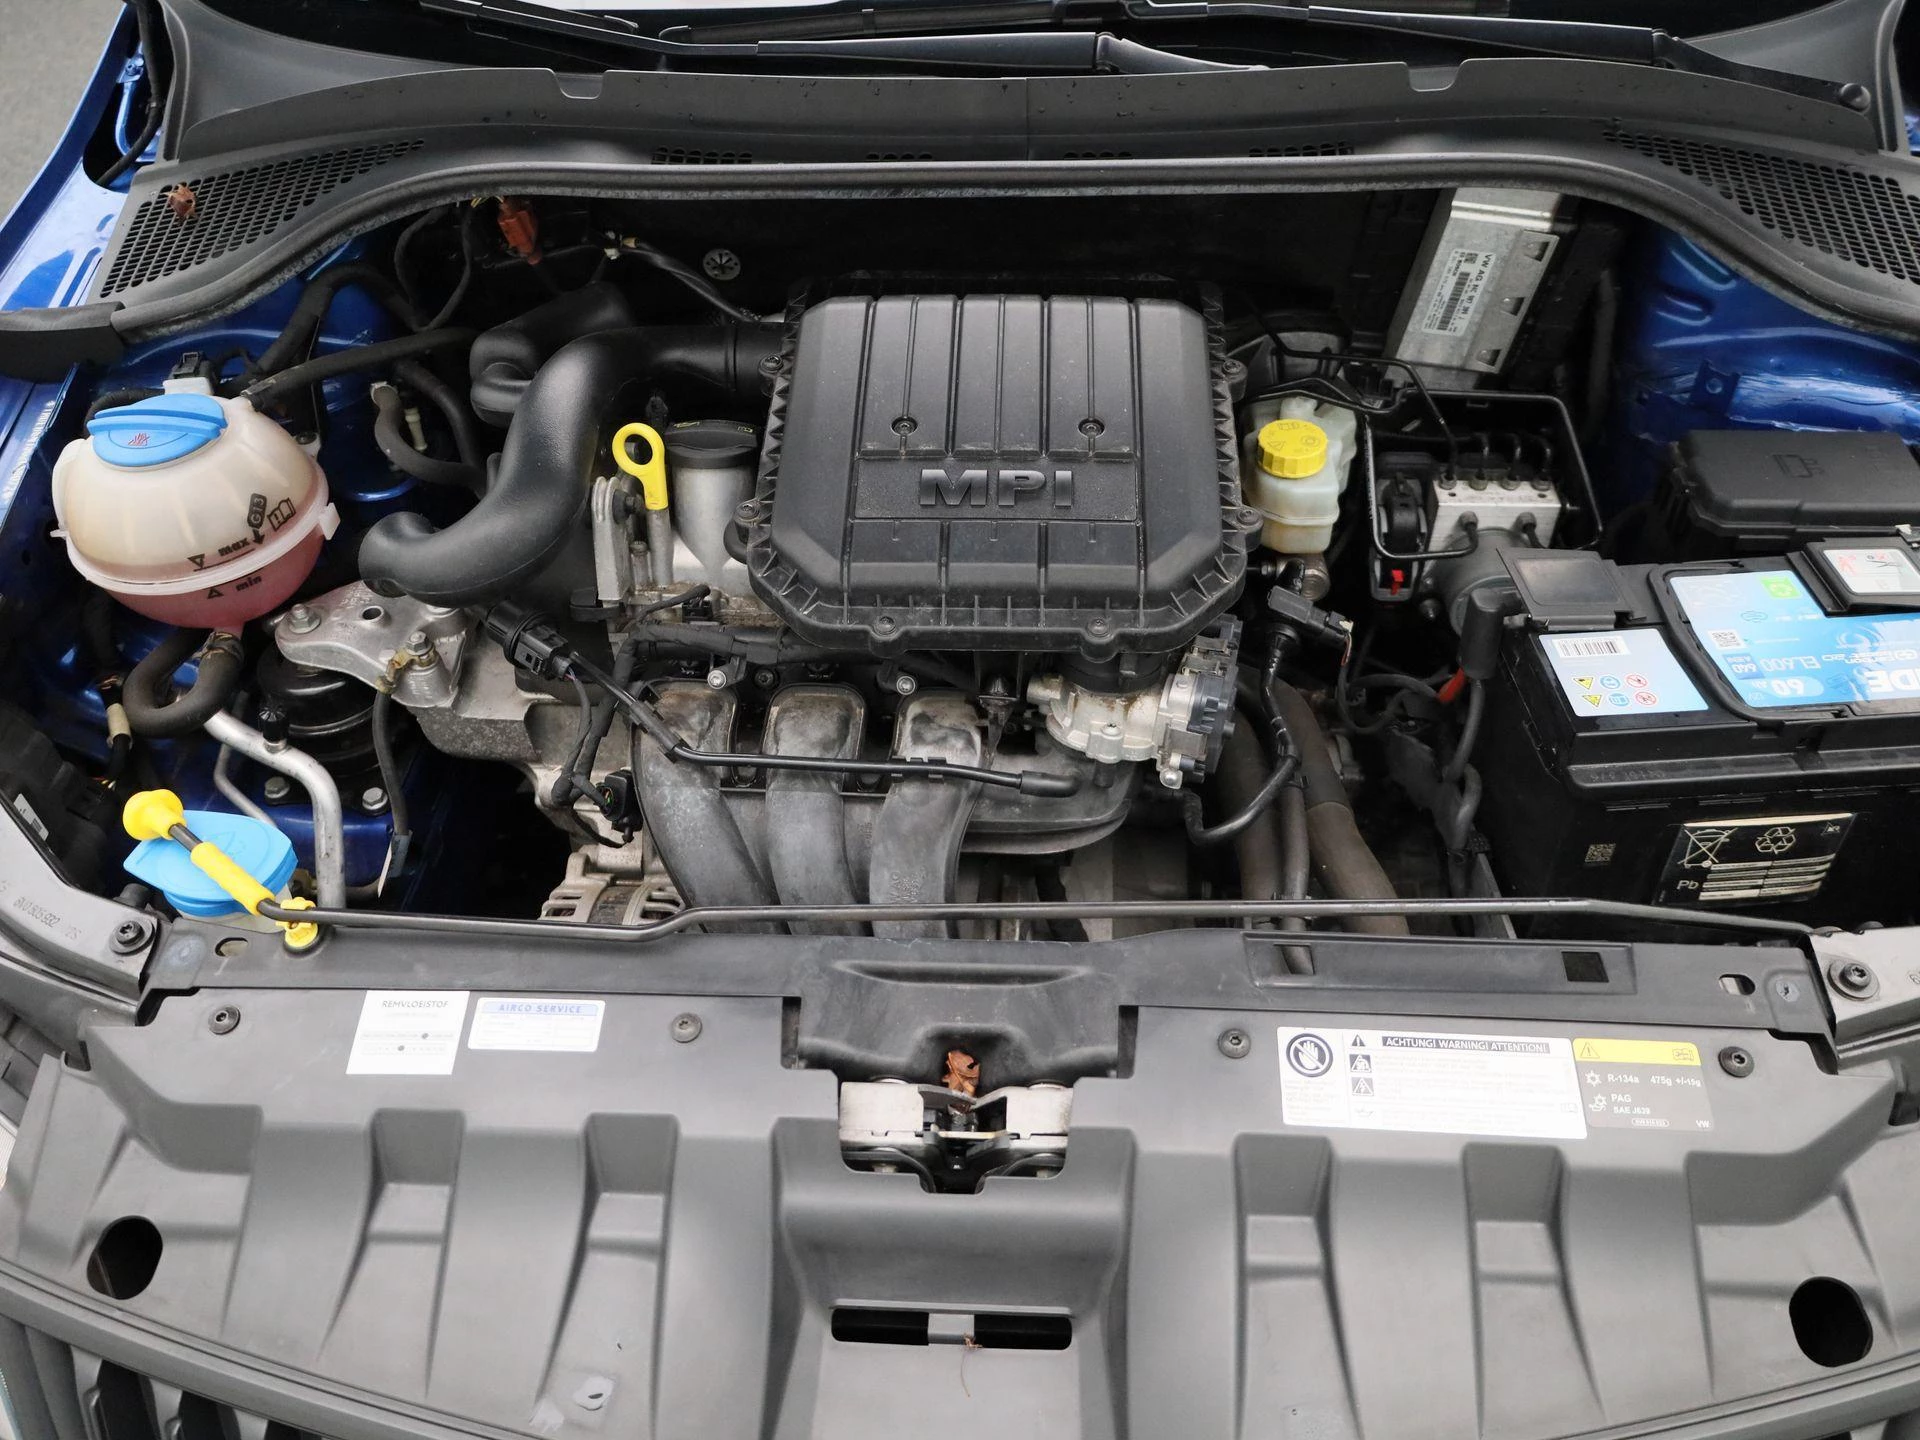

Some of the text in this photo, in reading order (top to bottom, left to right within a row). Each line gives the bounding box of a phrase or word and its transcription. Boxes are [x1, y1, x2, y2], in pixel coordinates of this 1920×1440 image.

[1481, 254, 1492, 268] VW
[1475, 269, 1485, 281] AG
[920, 469, 1072, 508] MPI
[250, 496, 265, 524] G13
[218, 538, 250, 556] max
[236, 576, 262, 592] min
[1731, 663, 1757, 674] 640
[1760, 655, 1821, 672] EL600
[1770, 679, 1804, 697] 60
[1676, 880, 1700, 890] Pb
[382, 1000, 449, 1008] REMVLOEISTOF
[498, 1004, 582, 1013] AIRCO SERVICE
[1386, 1037, 1547, 1052] ACHTUNG! WARNING! ATTENTION!
[1607, 1073, 1701, 1087] R-134a 475g +/-15g
[1611, 1093, 1632, 1102] PAG
[1613, 1106, 1631, 1114] SAE
[1695, 1120, 1710, 1128] VW
